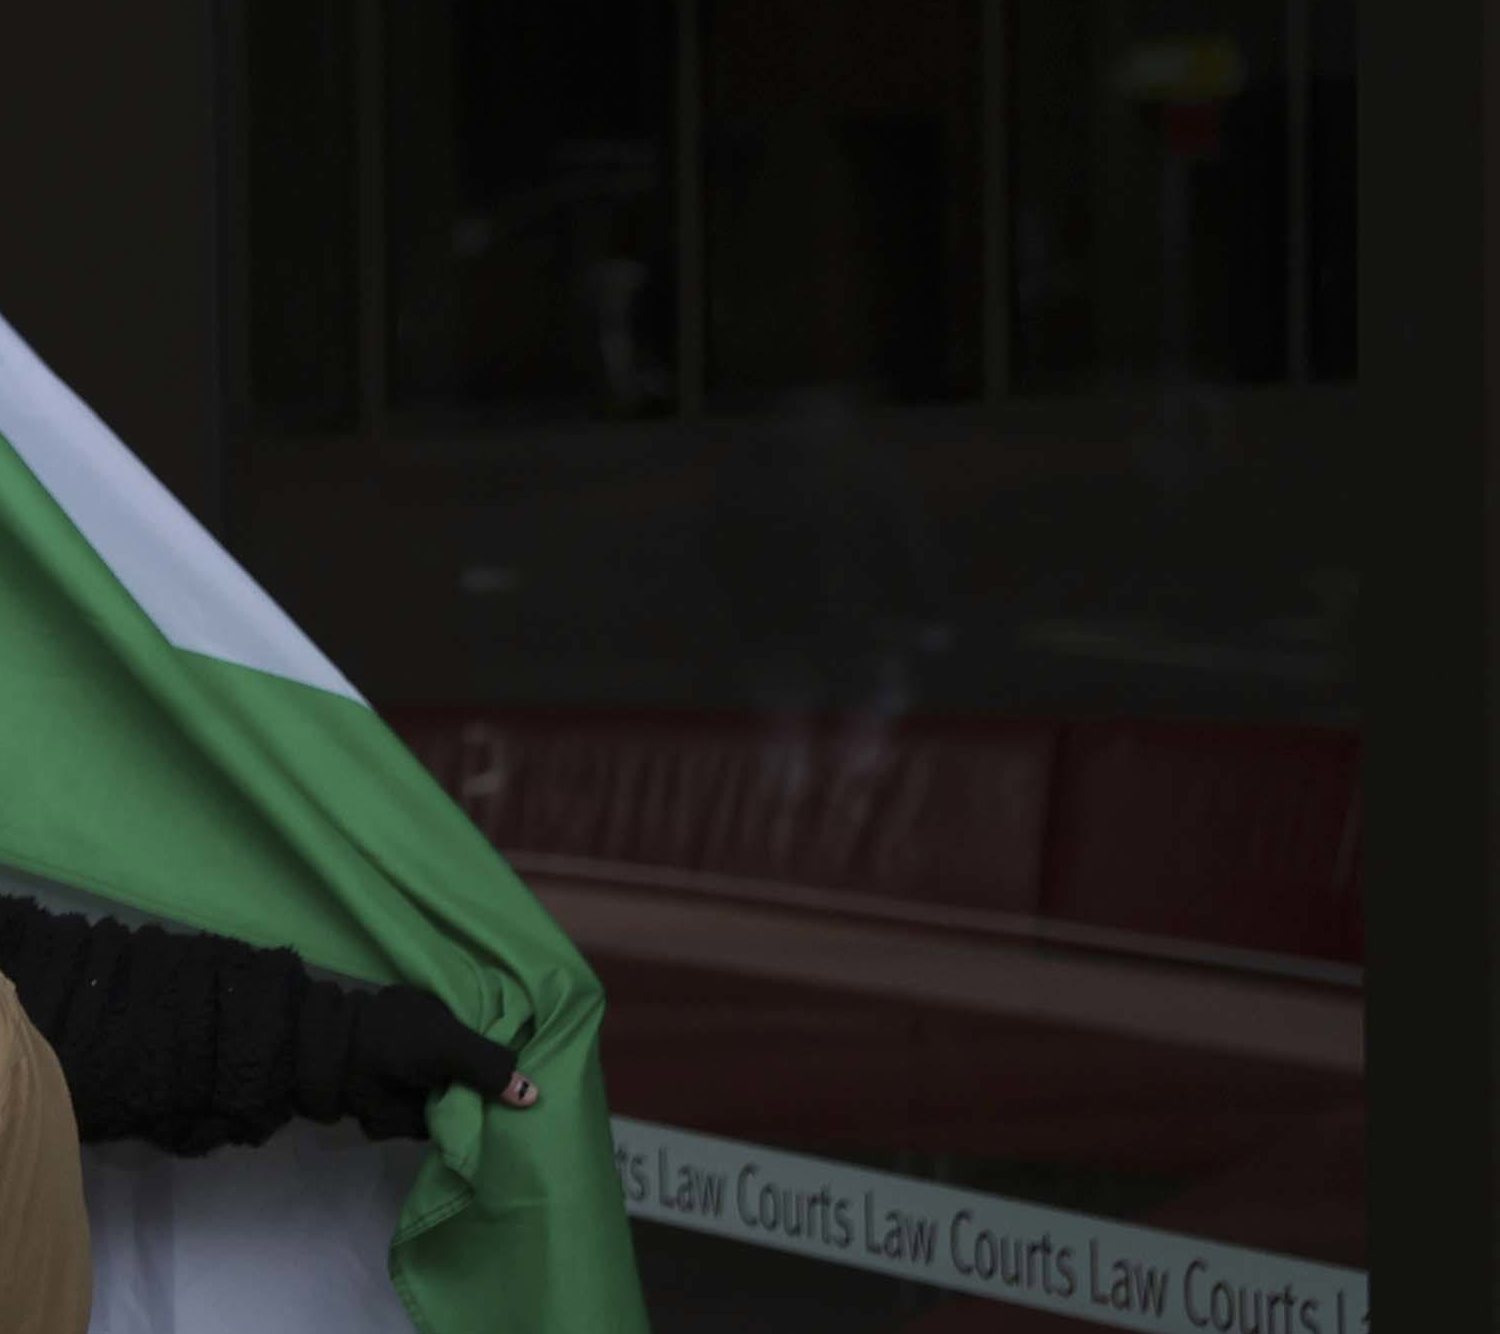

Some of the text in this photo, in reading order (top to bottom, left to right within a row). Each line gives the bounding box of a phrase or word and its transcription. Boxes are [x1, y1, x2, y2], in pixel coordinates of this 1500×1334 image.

[658, 1147, 725, 1217] Law
[737, 1162, 853, 1249] Courts
[864, 1191, 937, 1264] Law
[950, 1208, 1077, 1298] Courts
[1089, 1237, 1170, 1318] Law
